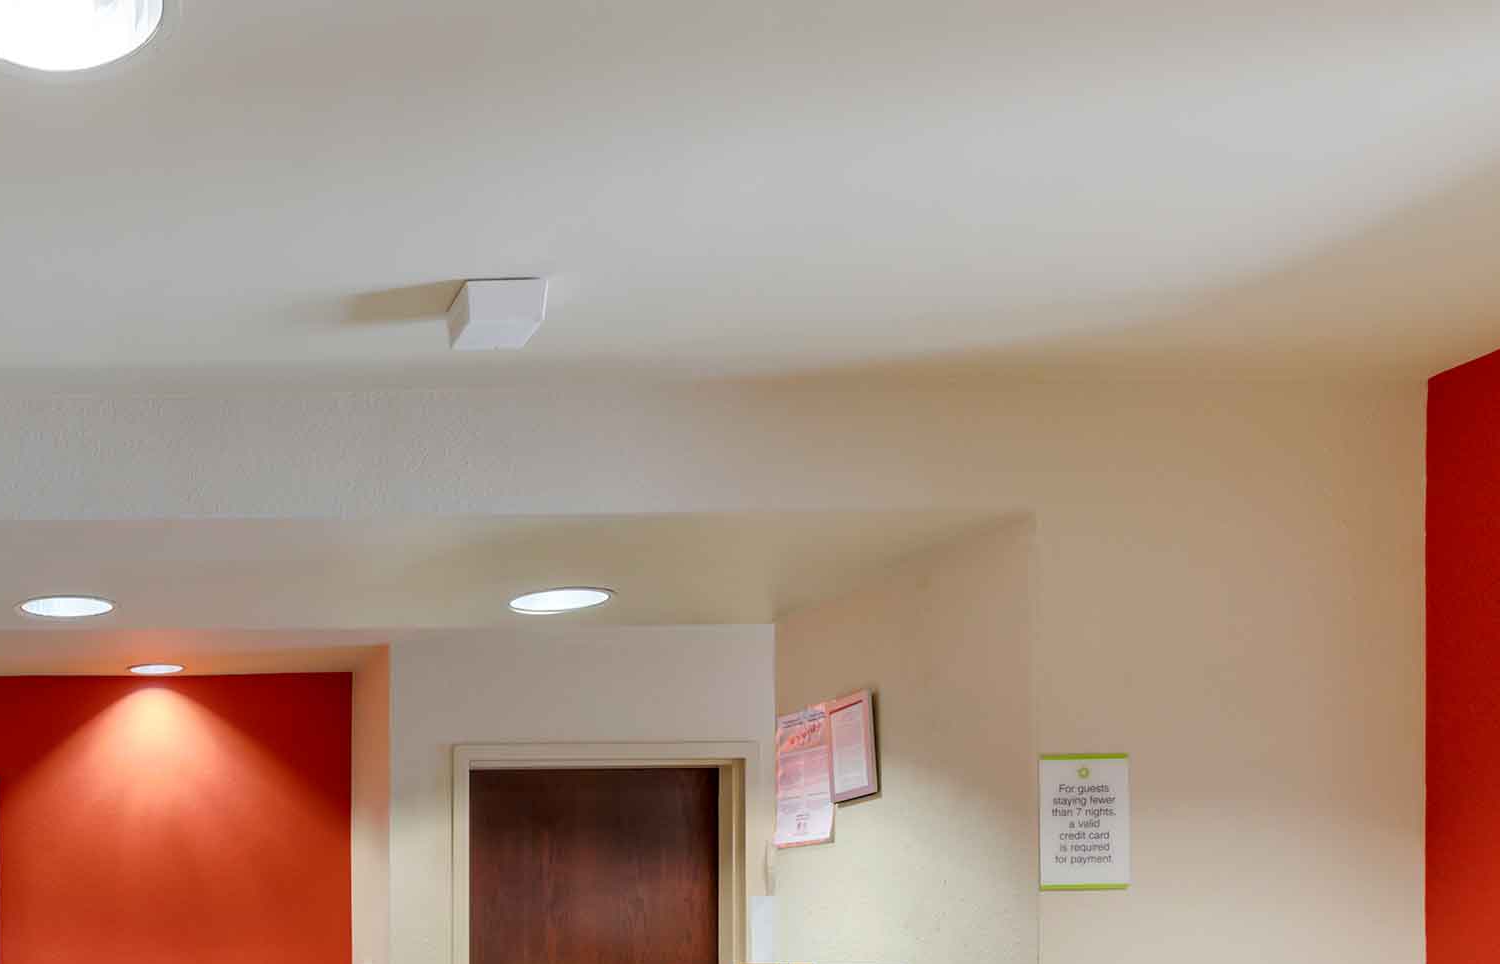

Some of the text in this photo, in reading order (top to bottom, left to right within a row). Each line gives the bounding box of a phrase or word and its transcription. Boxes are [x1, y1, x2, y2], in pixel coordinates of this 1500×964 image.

[1058, 783, 1110, 796] For guests
[1052, 795, 1116, 807] staying fewer
[1051, 807, 1073, 817] than
[1075, 807, 1082, 817] 7
[1068, 819, 1101, 829] a valid
[1059, 831, 1110, 841] credit card
[1059, 842, 1111, 853] is required
[1054, 855, 1068, 864] for
